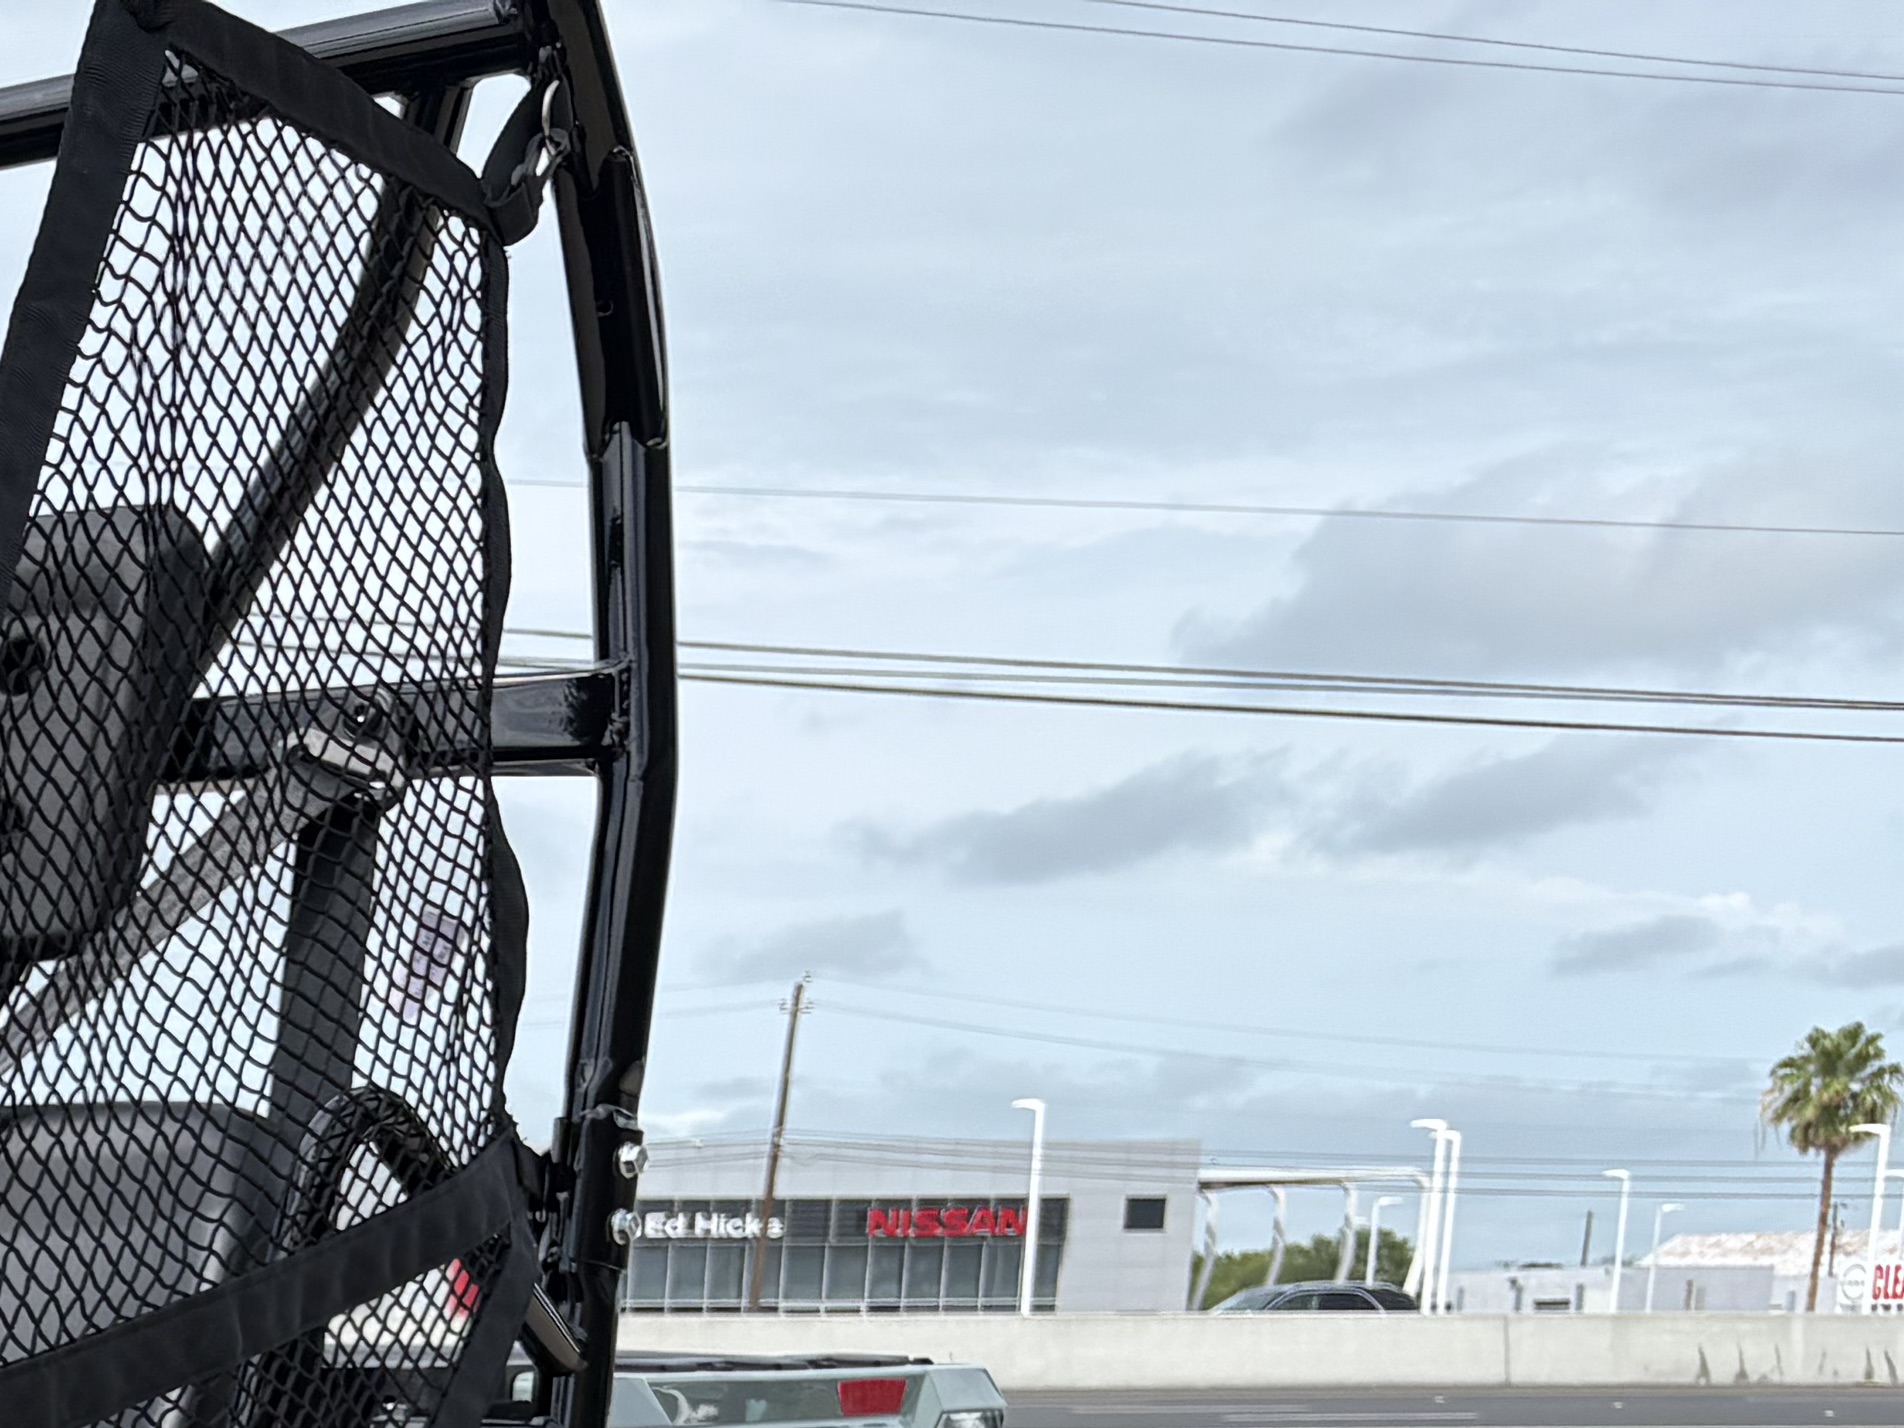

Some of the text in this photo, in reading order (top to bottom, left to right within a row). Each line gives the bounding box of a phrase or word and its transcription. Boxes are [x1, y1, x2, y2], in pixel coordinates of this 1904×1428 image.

[644, 1211, 784, 1239] Ed Hicks
[867, 1205, 1027, 1238] NISSAN
[1872, 1264, 1904, 1300] CLE
